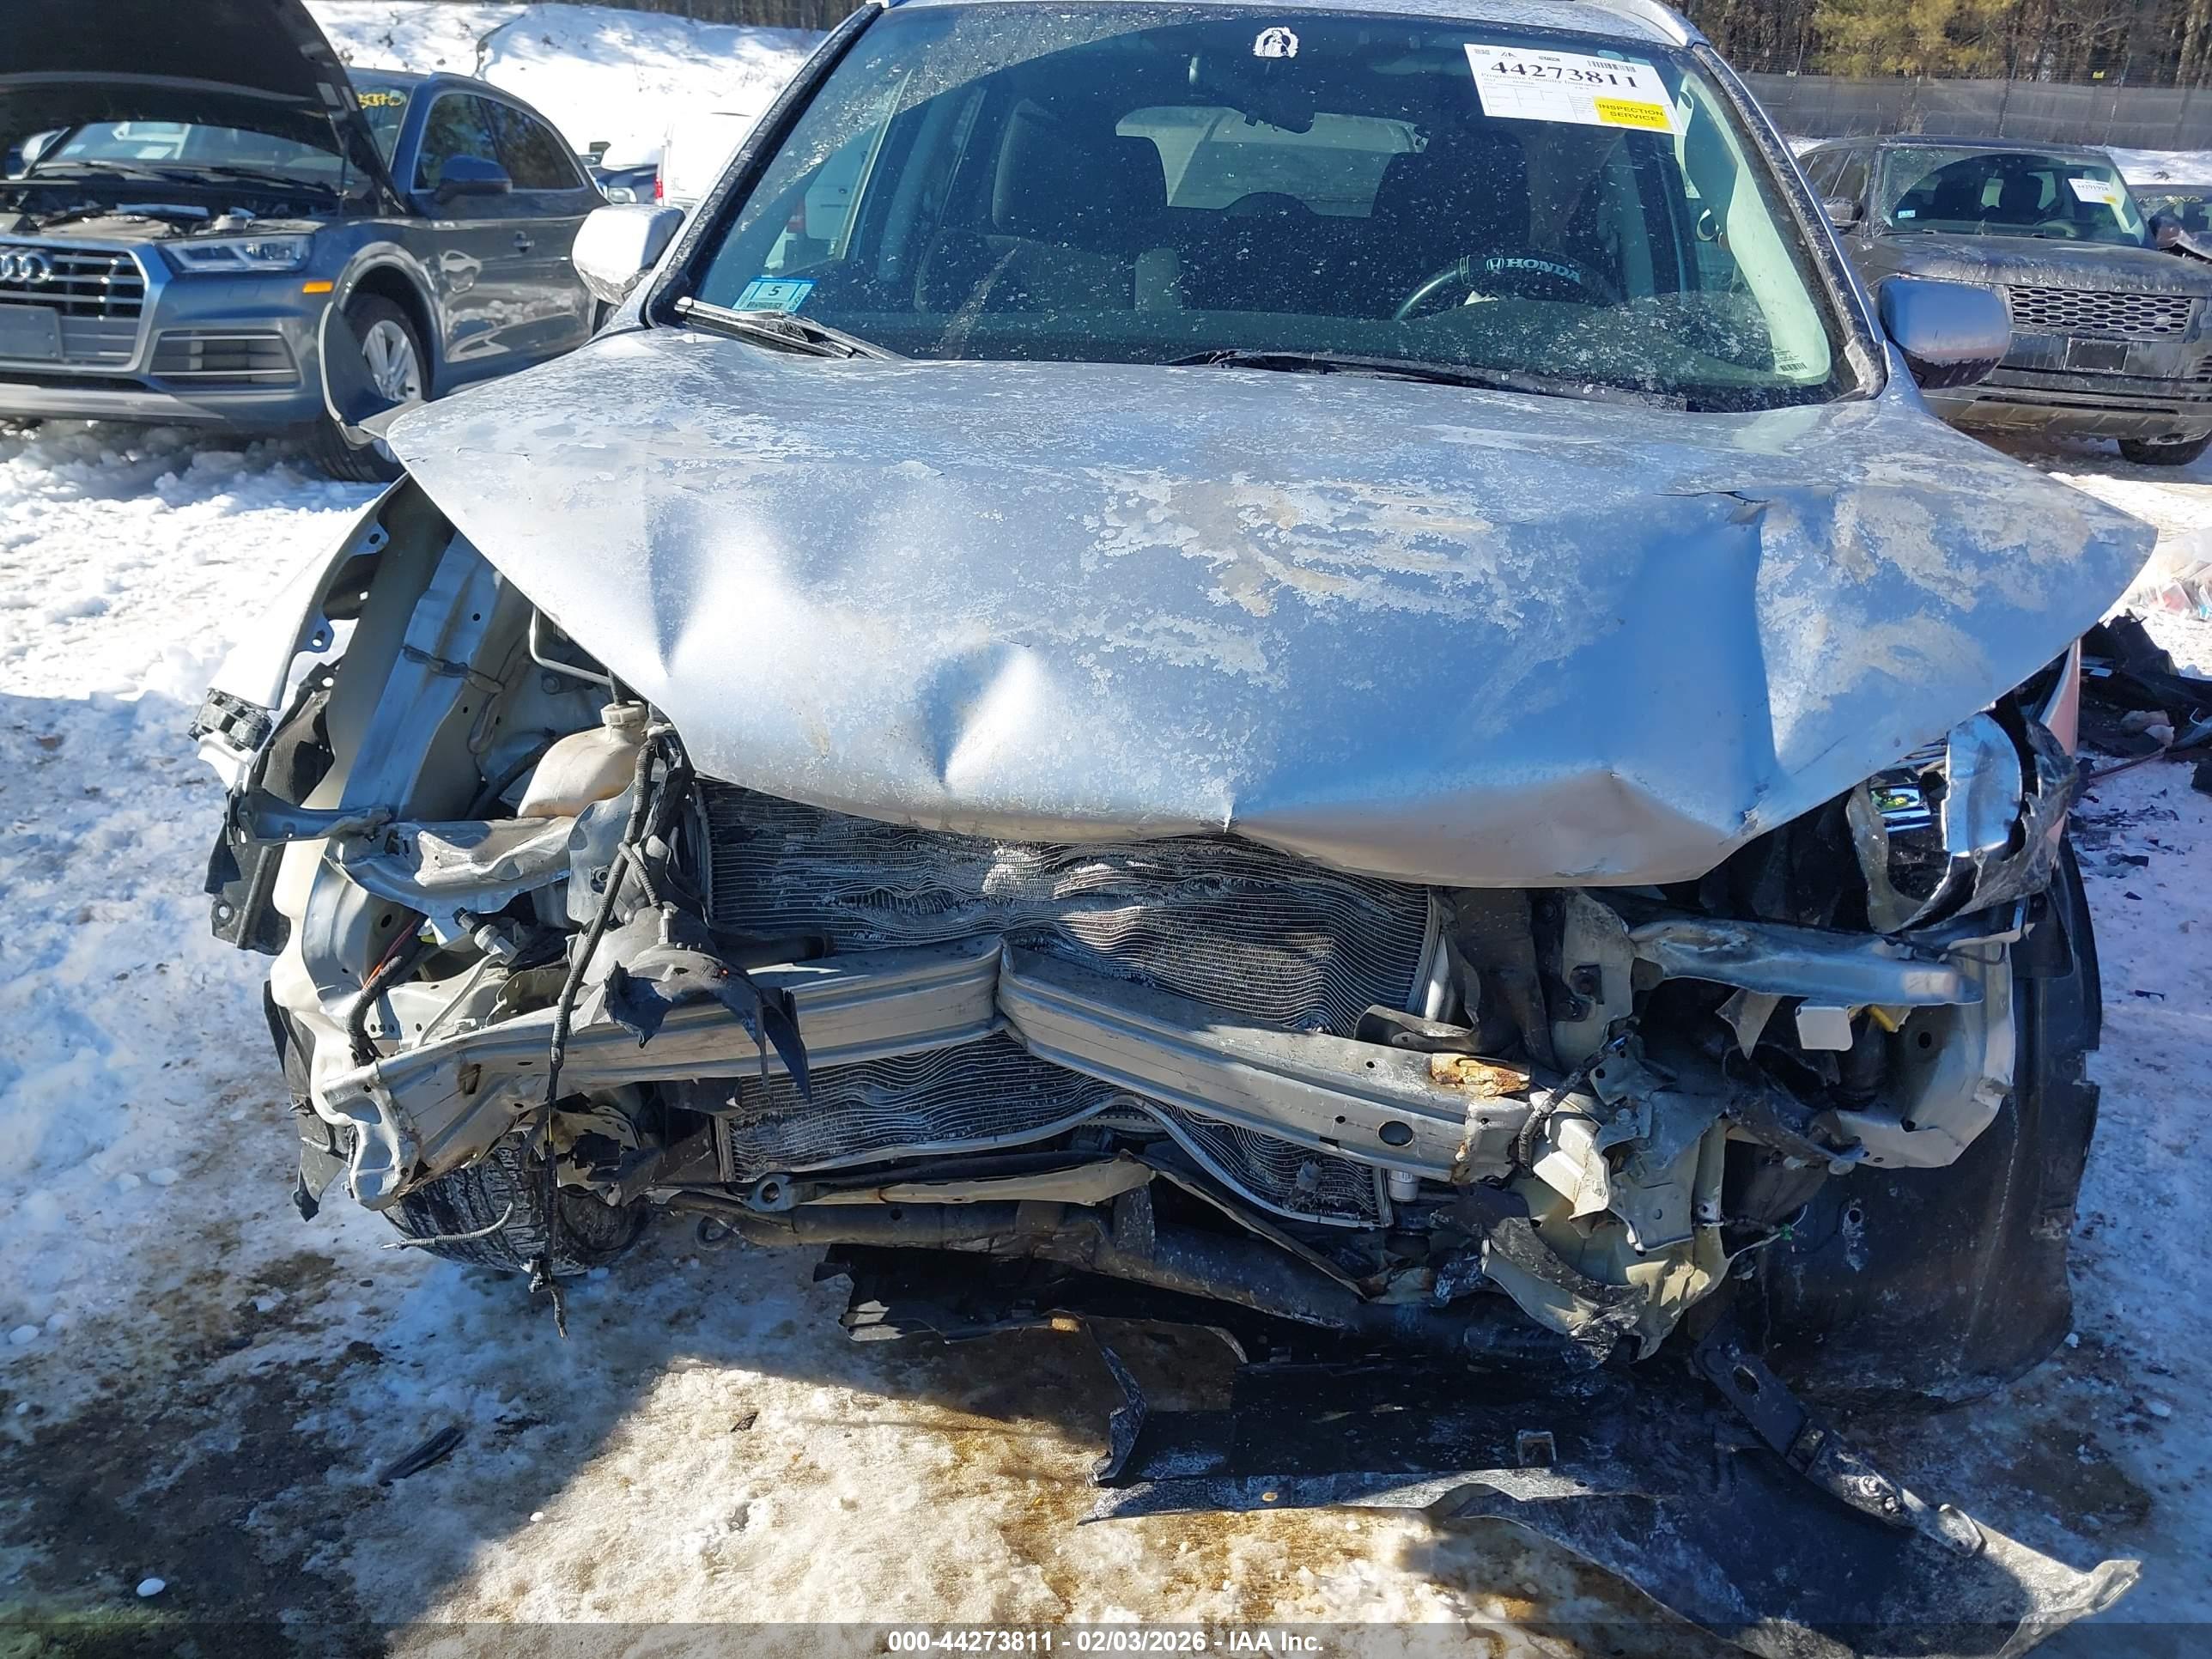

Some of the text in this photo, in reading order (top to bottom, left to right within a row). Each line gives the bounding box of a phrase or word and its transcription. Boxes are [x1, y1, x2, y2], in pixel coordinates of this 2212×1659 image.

[1491, 61, 1640, 88] 44273811
[1598, 103, 1664, 117] INSPECTION
[1610, 111, 1659, 122] SERVICE
[1505, 258, 1581, 284] HONDA
[768, 285, 782, 296] 5
